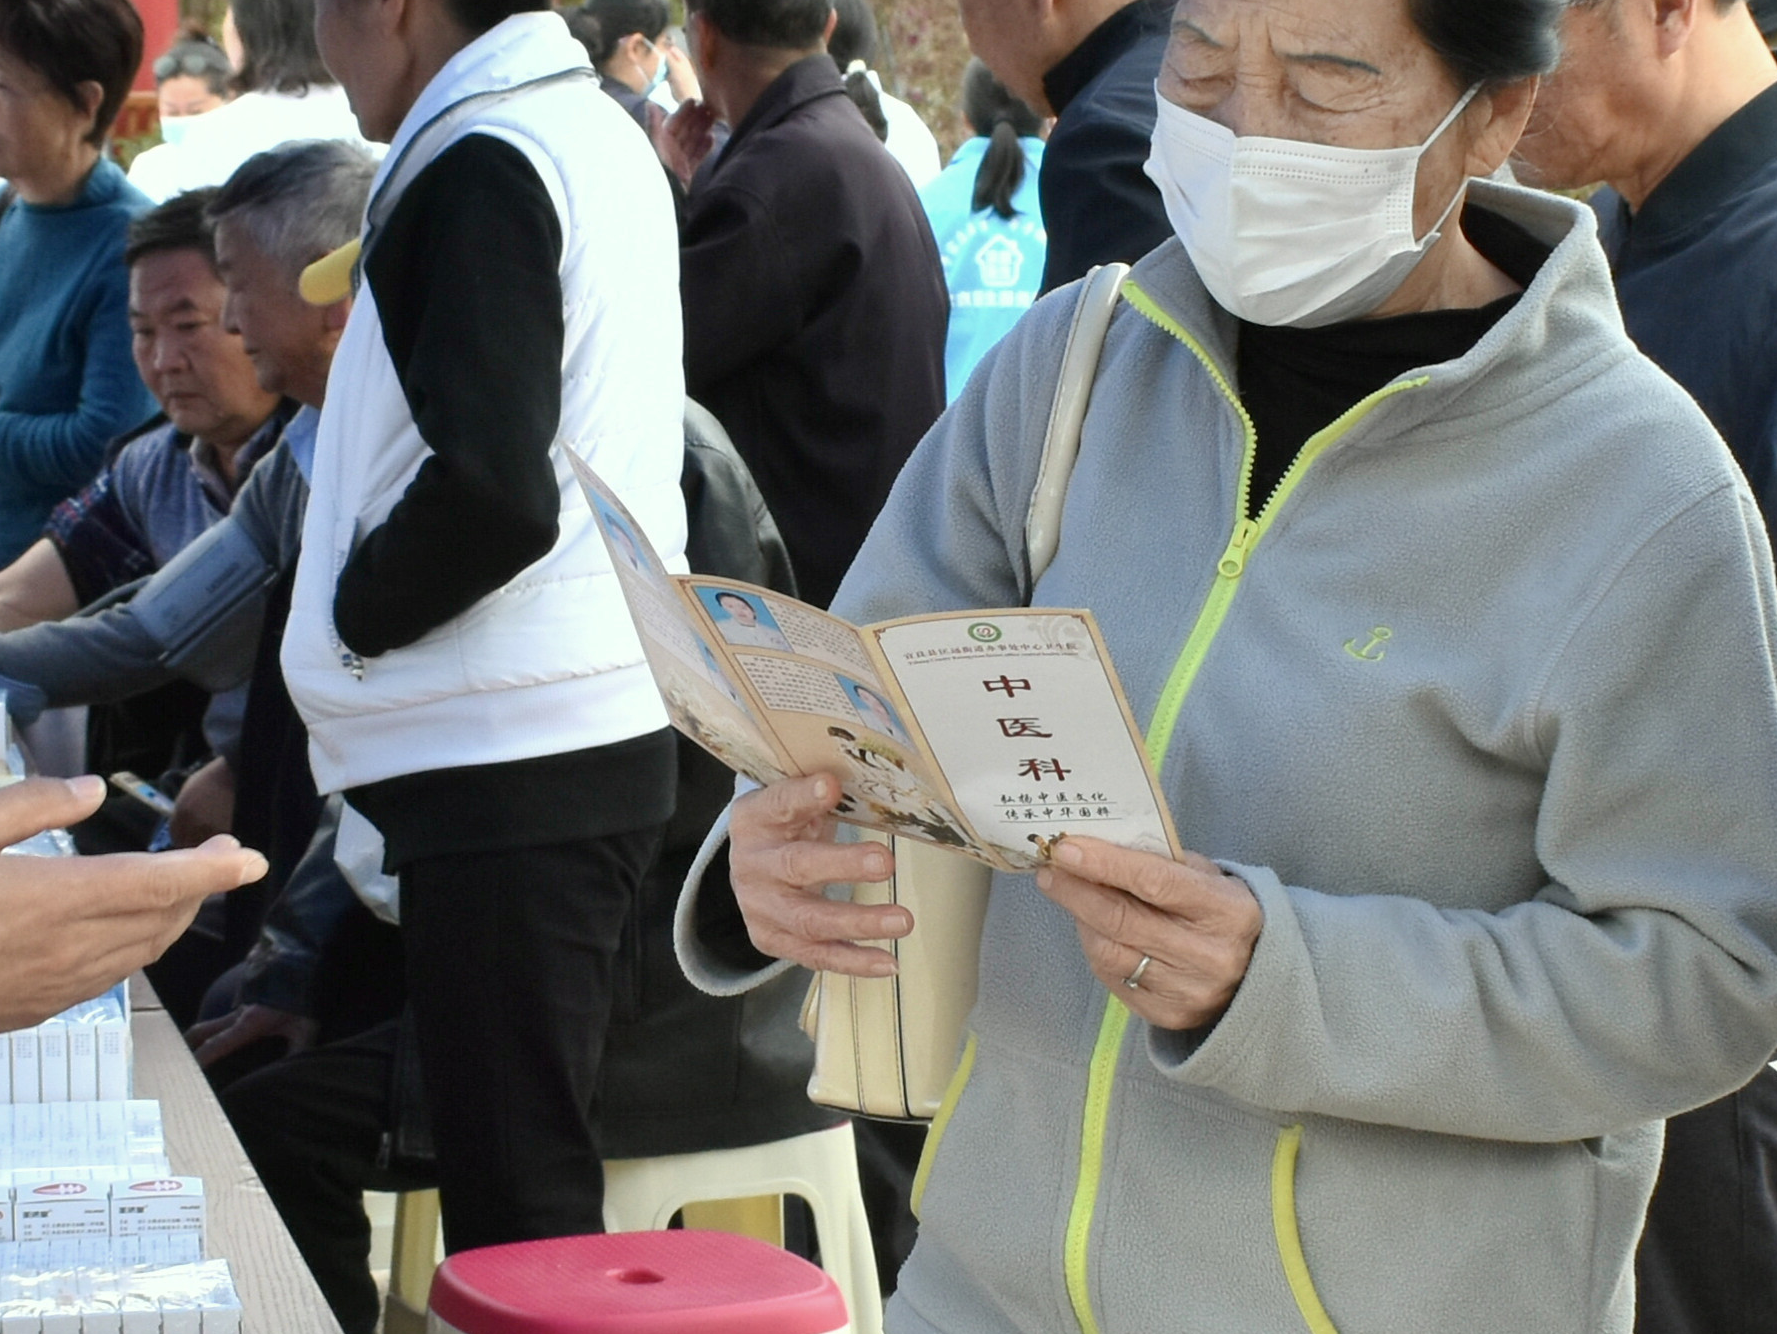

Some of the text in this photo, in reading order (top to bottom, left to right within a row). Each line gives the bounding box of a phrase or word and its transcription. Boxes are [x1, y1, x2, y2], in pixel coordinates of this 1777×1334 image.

[982, 675, 1072, 782] 中医科
[1005, 806, 1110, 820] 传承中华国粹
